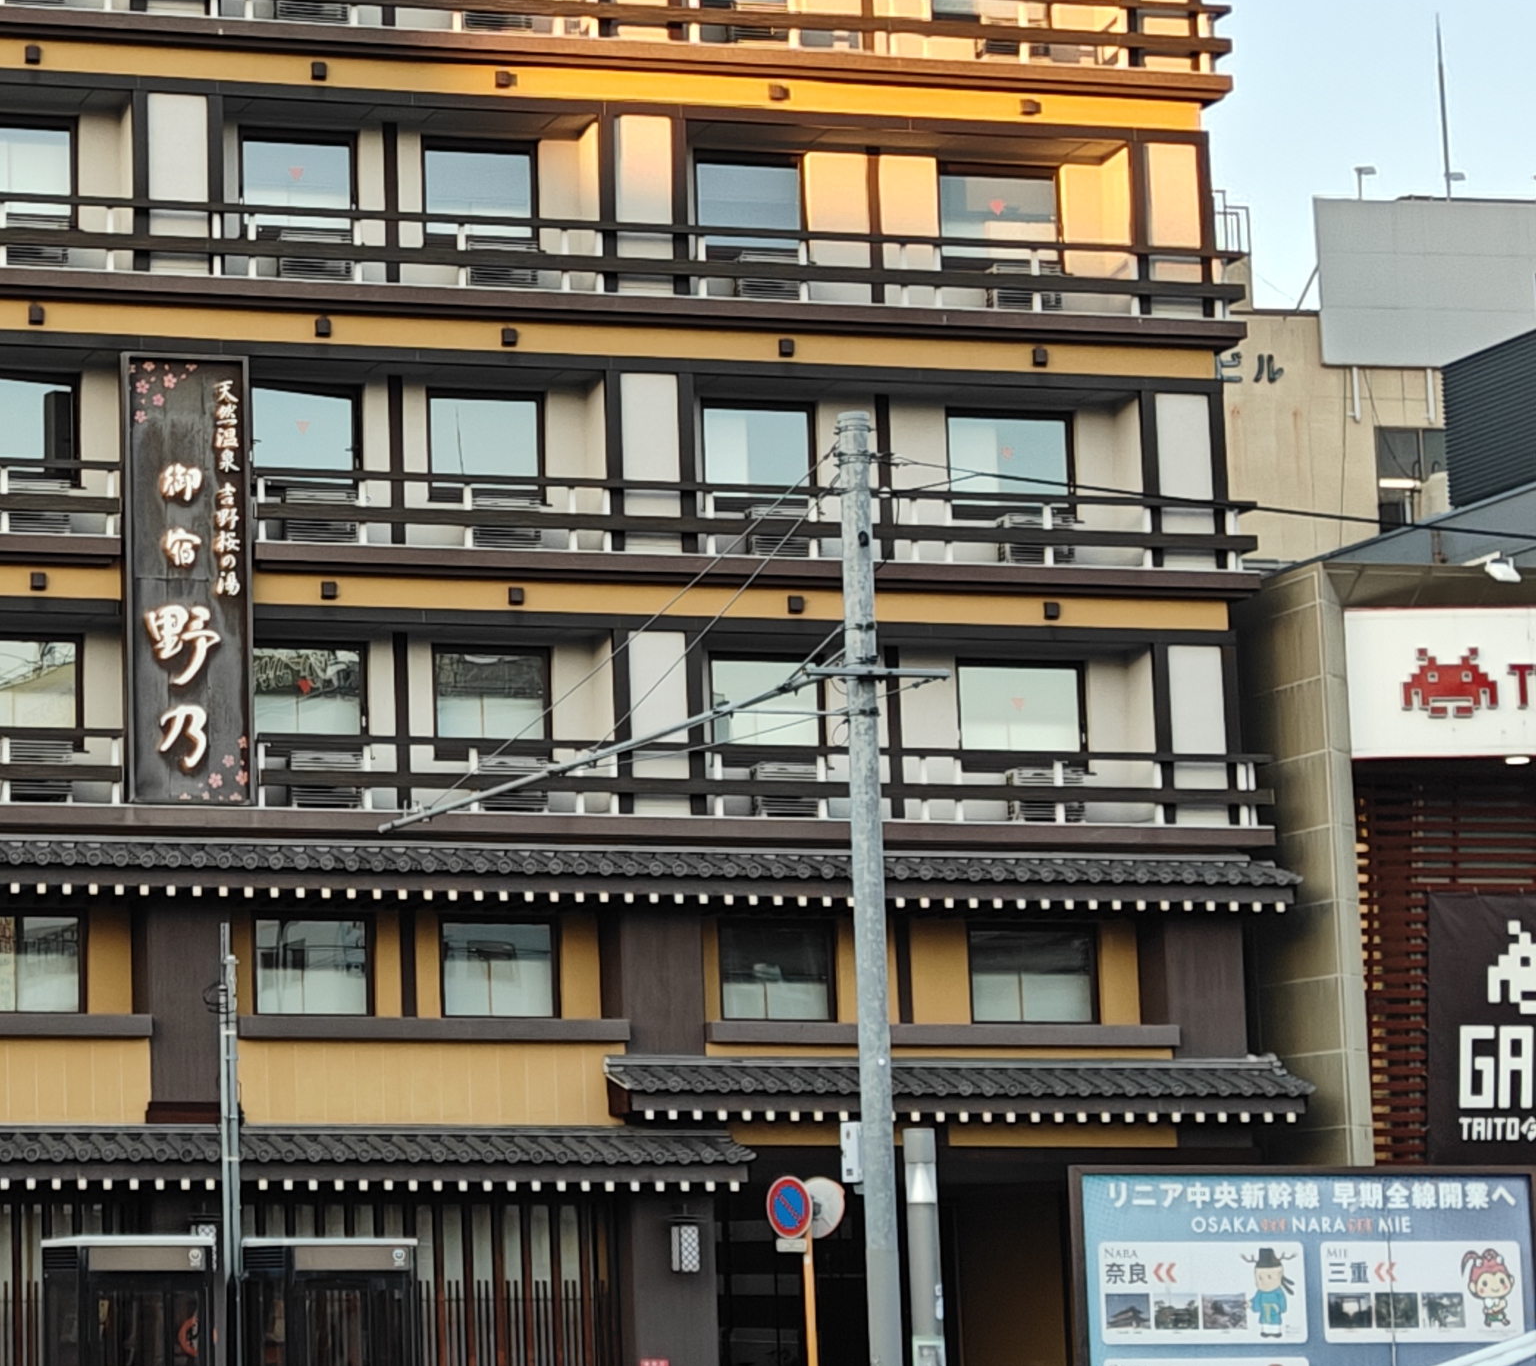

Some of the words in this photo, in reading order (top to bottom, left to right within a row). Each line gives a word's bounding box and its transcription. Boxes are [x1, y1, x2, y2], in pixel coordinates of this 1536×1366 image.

[215, 380, 240, 472] 天然温泉
[216, 482, 241, 596] 吉野桜の湯
[1458, 1117, 1520, 1141] TAITO
[1109, 1181, 1320, 1210] リニア中央新幹線
[1332, 1181, 1516, 1210] 早期全線開業へ
[1191, 1216, 1260, 1233] OSAKA
[1292, 1216, 1346, 1233] NARA
[1378, 1215, 1411, 1233] MIE
[1105, 1262, 1148, 1285] 奈良
[1328, 1261, 1370, 1283] 三重
